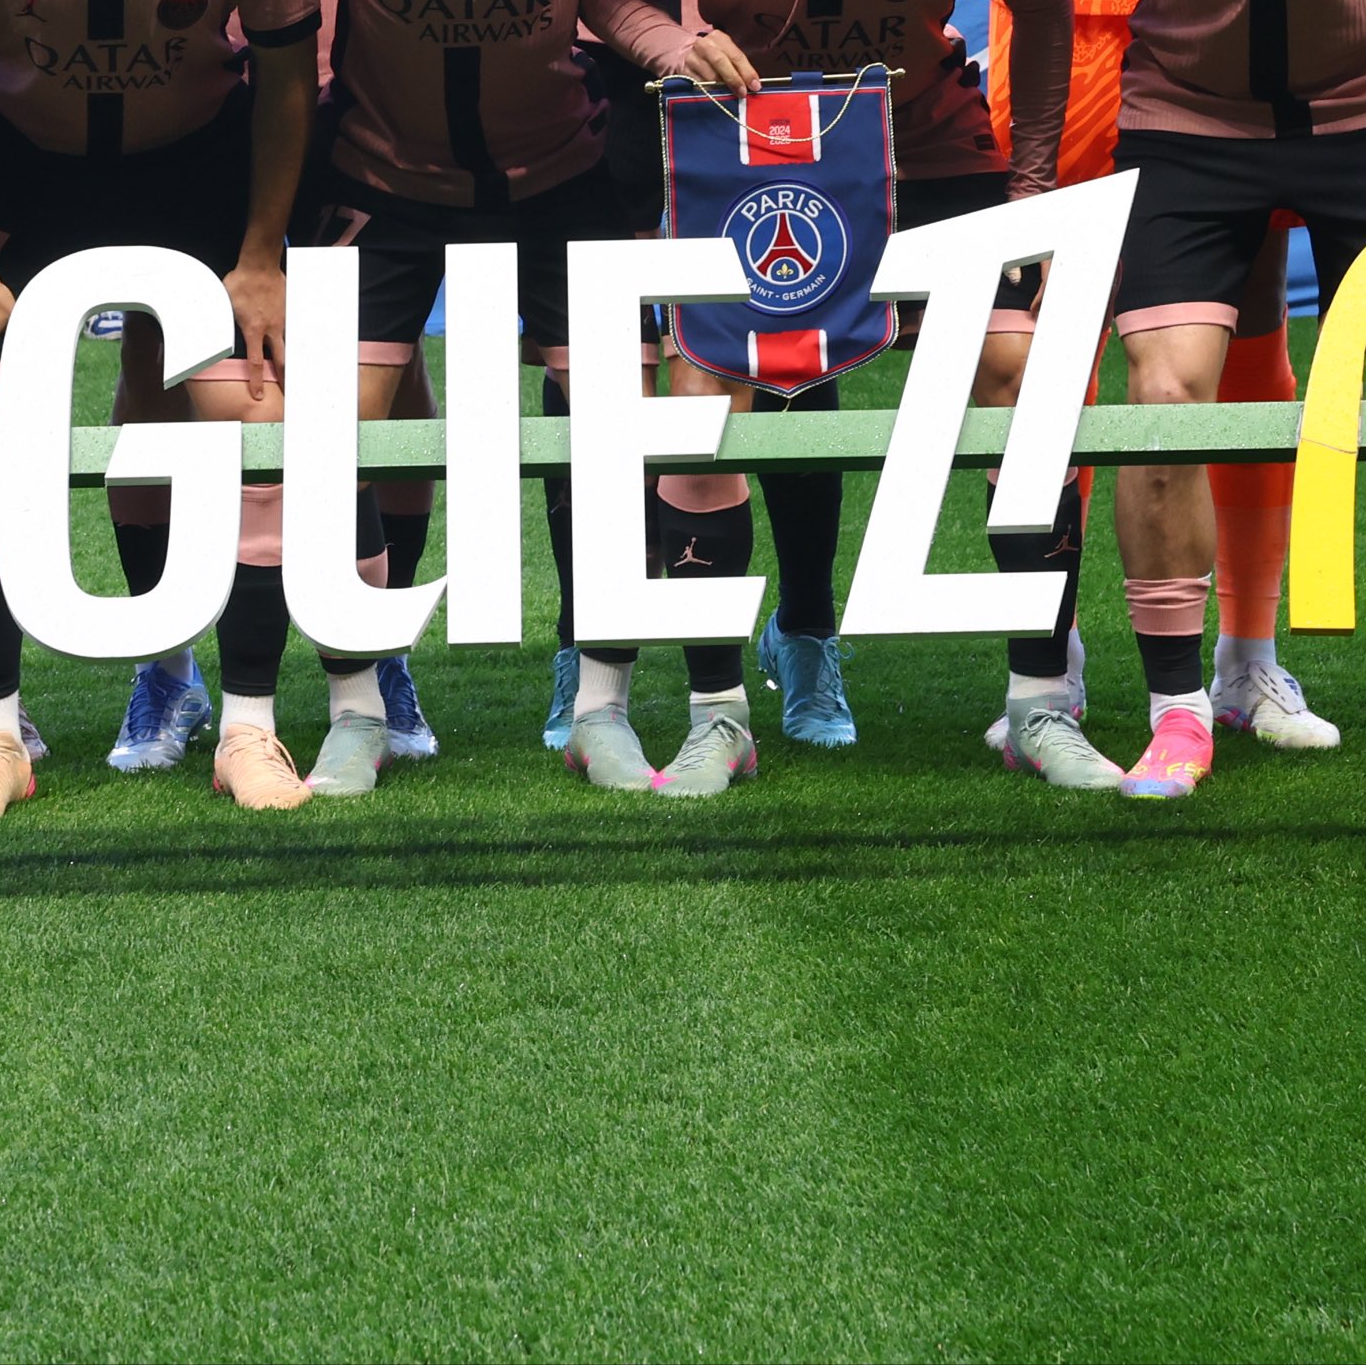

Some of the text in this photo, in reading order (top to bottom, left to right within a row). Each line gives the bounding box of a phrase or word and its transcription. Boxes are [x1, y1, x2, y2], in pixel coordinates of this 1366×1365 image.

[418, 8, 553, 44] AIRWAYS
[62, 71, 171, 90] AIRWA
[769, 125, 791, 135] 2024
[740, 190, 824, 223] PARIS
